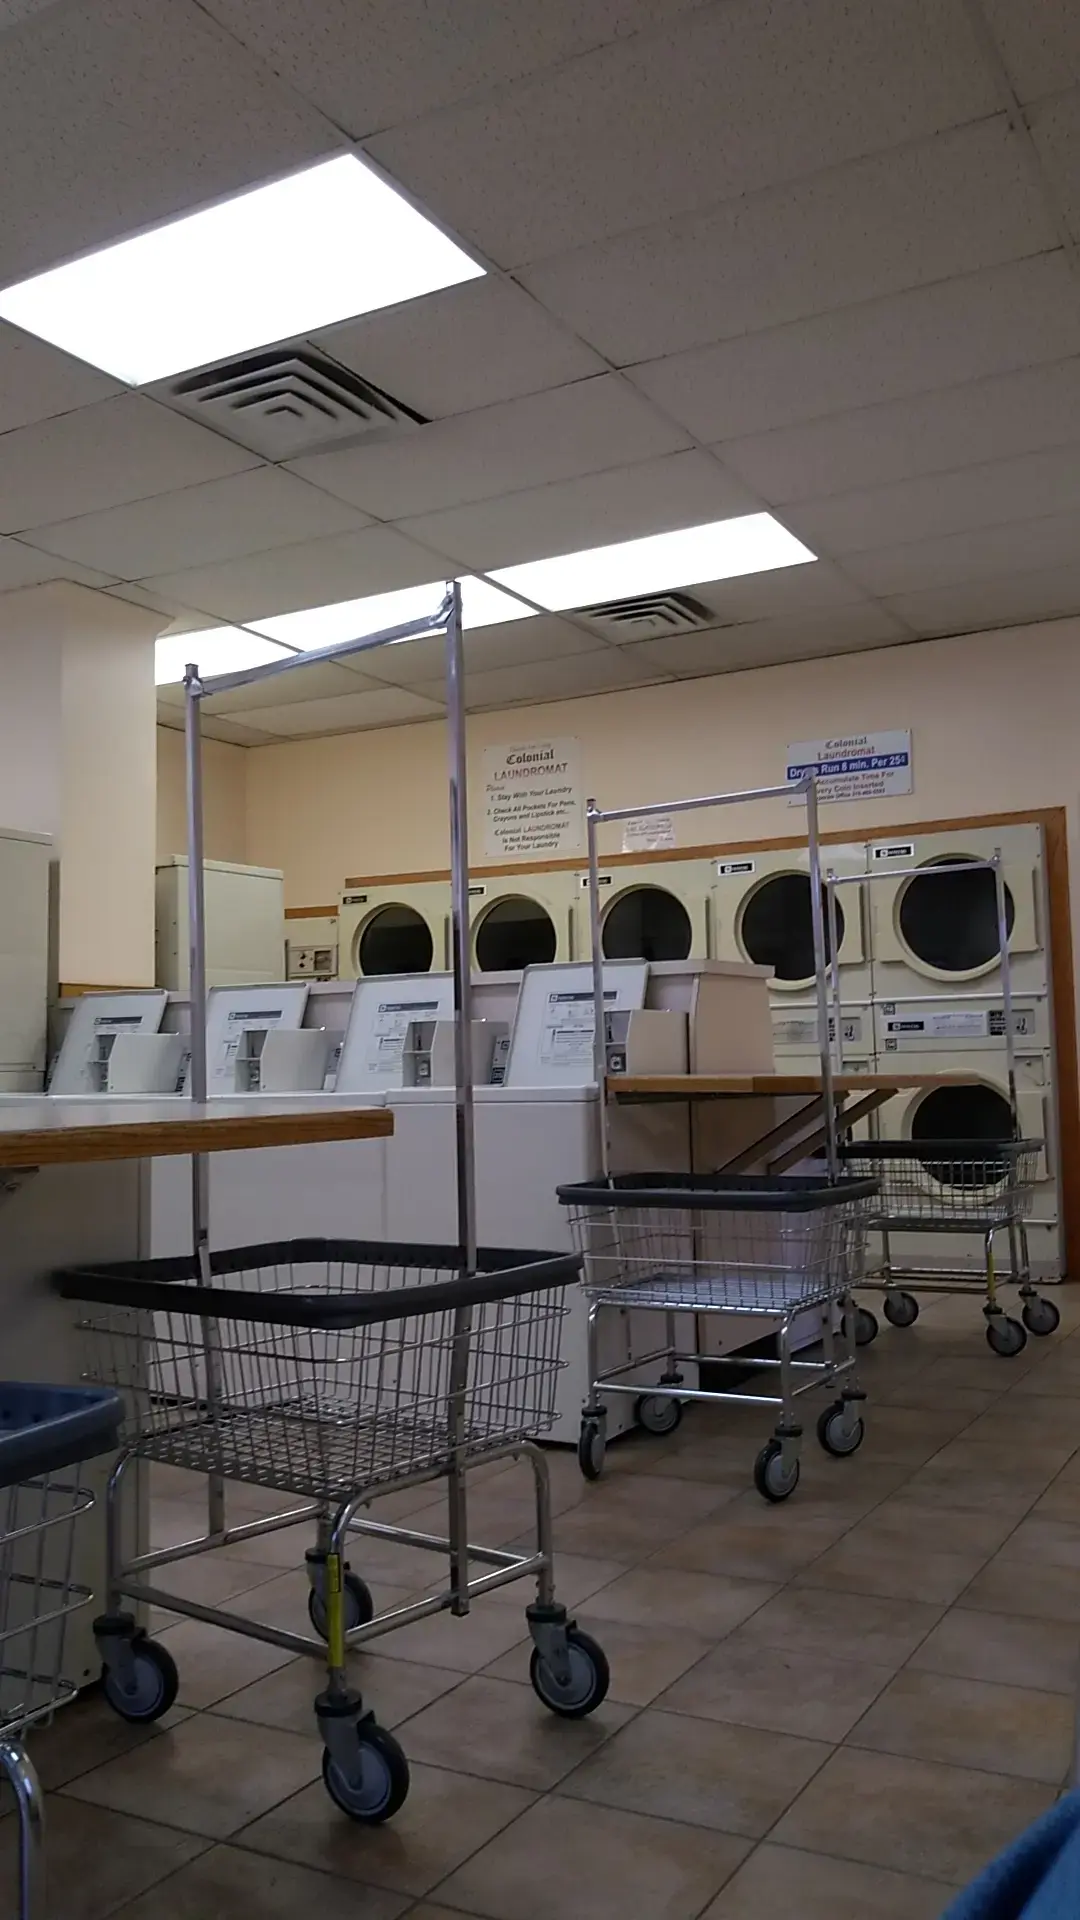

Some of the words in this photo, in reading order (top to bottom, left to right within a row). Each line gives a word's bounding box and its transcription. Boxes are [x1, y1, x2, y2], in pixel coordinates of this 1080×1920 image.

[825, 736, 867, 749] Colonial
[506, 749, 554, 765] Colonial
[817, 746, 875, 760] Laundromat
[494, 763, 568, 781] LAUNDROMAT
[821, 764, 840, 774] Run
[849, 759, 869, 770] min.
[871, 757, 887, 768] Per
[861, 772, 879, 780] Time
[881, 770, 895, 778] For
[853, 781, 884, 790] Inserted
[498, 794, 511, 802] Stay
[513, 790, 528, 798] With
[529, 789, 544, 797] Your
[545, 786, 572, 796] Laundry
[493, 807, 511, 815] Check
[522, 803, 546, 811] Pockets
[493, 815, 517, 823] Crayons
[531, 810, 554, 818] Lipstick
[494, 827, 521, 836] Colonial
[523, 822, 569, 833] LAUNDROMAT
[522, 832, 560, 842] Responsible
[532, 841, 559, 849] Laundry
